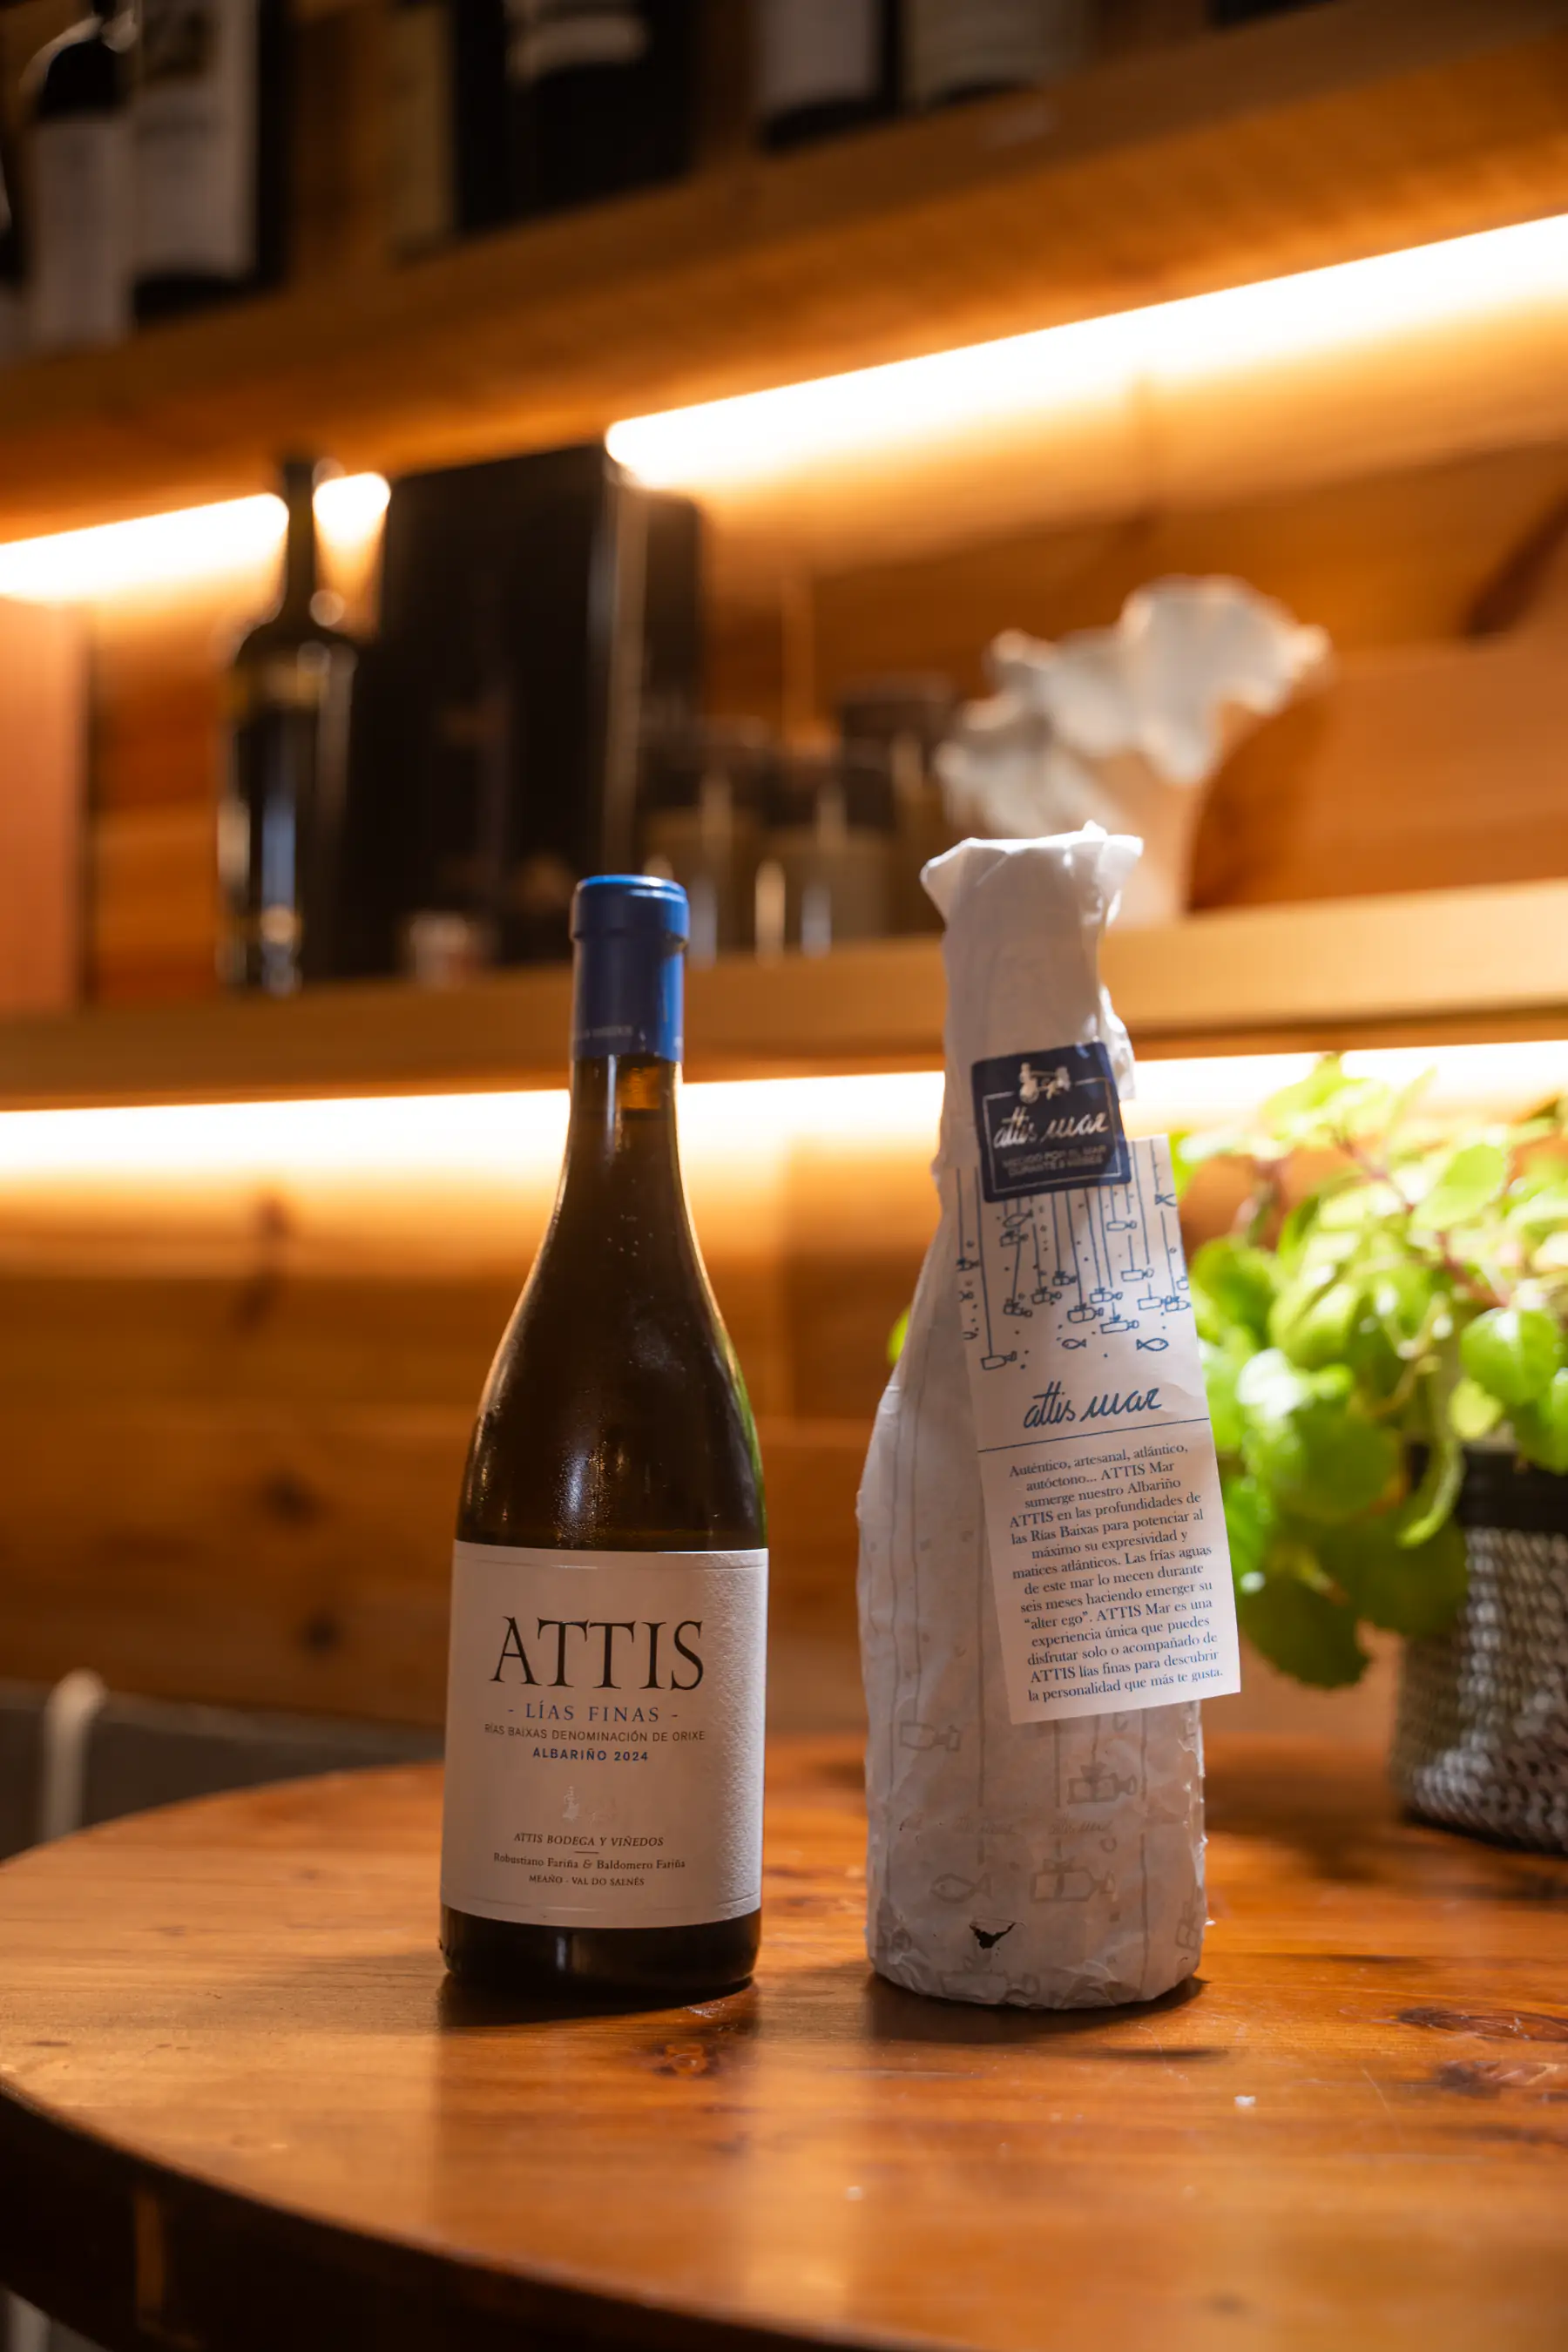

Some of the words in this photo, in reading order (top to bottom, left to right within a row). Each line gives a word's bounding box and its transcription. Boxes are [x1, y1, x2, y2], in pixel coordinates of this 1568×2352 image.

[1024, 1381, 1076, 1429] attis
[1080, 1388, 1162, 1422] mar
[1009, 1458, 1071, 1477] Auténtico,
[1074, 1450, 1130, 1467] artesanal,
[1133, 1444, 1188, 1460] atlántico,
[1026, 1475, 1097, 1491] autóctono...
[1100, 1464, 1145, 1480] ATTIS
[1150, 1462, 1174, 1473] Mar
[1025, 1494, 1075, 1509] sumerge
[1078, 1487, 1124, 1500] nuestro
[1127, 1479, 1180, 1494] Albariño
[1010, 1511, 1053, 1528] ATTIS
[1058, 1511, 1071, 1521] en
[1076, 1506, 1092, 1517] las
[1095, 1495, 1182, 1517] profundidades
[1186, 1492, 1201, 1504] de
[1011, 1533, 1027, 1544] las
[1031, 1528, 1056, 1542] Rías
[1060, 1524, 1098, 1538] Baixas
[1103, 1522, 1129, 1534] para
[1132, 1512, 1189, 1528] potenciar
[1193, 1509, 1203, 1520] al
[1031, 1544, 1080, 1558] máximo
[1085, 1541, 1098, 1551] su
[1102, 1530, 1177, 1550] expresividad
[1181, 1531, 1187, 1542] y
[1012, 1565, 1058, 1579] matices
[1061, 1558, 1121, 1572] atlánticos.
[1125, 1552, 1146, 1564] Las
[1150, 1549, 1175, 1561] frías
[1179, 1546, 1212, 1559] aguas
[1024, 1584, 1039, 1595] de
[1043, 1582, 1066, 1592] este
[1070, 1578, 1095, 1589] mar
[1098, 1574, 1110, 1585] lo
[1113, 1571, 1153, 1583] mecen
[1158, 1564, 1203, 1578] durante
[1020, 1600, 1042, 1612] seis
[1045, 1596, 1083, 1609] meses
[1087, 1589, 1142, 1605] haciendo
[1146, 1584, 1195, 1598] emerger
[1199, 1581, 1212, 1591] su
[1097, 1605, 1141, 1621] ATTIS
[1146, 1602, 1170, 1615] Mar
[1174, 1602, 1186, 1612] es
[1191, 1599, 1213, 1610] una
[1031, 1629, 1101, 1648] experiencia
[1105, 1625, 1138, 1638] única
[1141, 1622, 1164, 1636] que
[1167, 1616, 1210, 1632] puedes
[489, 1616, 704, 1691] ATTIS
[1028, 1651, 1078, 1666] disfrutar
[1082, 1646, 1107, 1659] solo
[1123, 1635, 1200, 1654] acompañado
[1203, 1632, 1218, 1643] de
[1031, 1666, 1075, 1684] ATTIS
[1079, 1664, 1099, 1677] lías
[1103, 1661, 1131, 1675] finas
[1134, 1659, 1160, 1673] para
[1164, 1650, 1219, 1668] descubrir
[1028, 1690, 1038, 1702] la
[1043, 1676, 1120, 1702] personalidad
[1125, 1679, 1146, 1692] que
[1151, 1673, 1174, 1686] más
[1178, 1672, 1188, 1682] te
[1192, 1668, 1223, 1682] gusta.
[526, 1700, 575, 1721] LÍAS
[589, 1706, 659, 1723] FINAS
[484, 1723, 505, 1736] RÍAS
[508, 1726, 547, 1740] BAIXAS
[552, 1729, 647, 1743] DENOMINACIÓN
[653, 1732, 667, 1742] DE
[672, 1731, 706, 1741] ORIXE
[532, 1747, 607, 1761] ALBARIÑO
[614, 1751, 648, 1761] 2024
[514, 1833, 543, 1843] ATTIS
[547, 1835, 595, 1846] BODEGA
[600, 1836, 607, 1847] Y
[612, 1836, 665, 1847] VIÑEDOS
[493, 1853, 544, 1867] Robustiano
[548, 1858, 578, 1869] Fariña
[583, 1860, 592, 1869] &
[597, 1860, 652, 1869] Baldomero
[656, 1859, 686, 1869] Fariña
[529, 1875, 563, 1884] MEAÑO
[571, 1876, 588, 1885] VAL
[592, 1877, 607, 1886] DO
